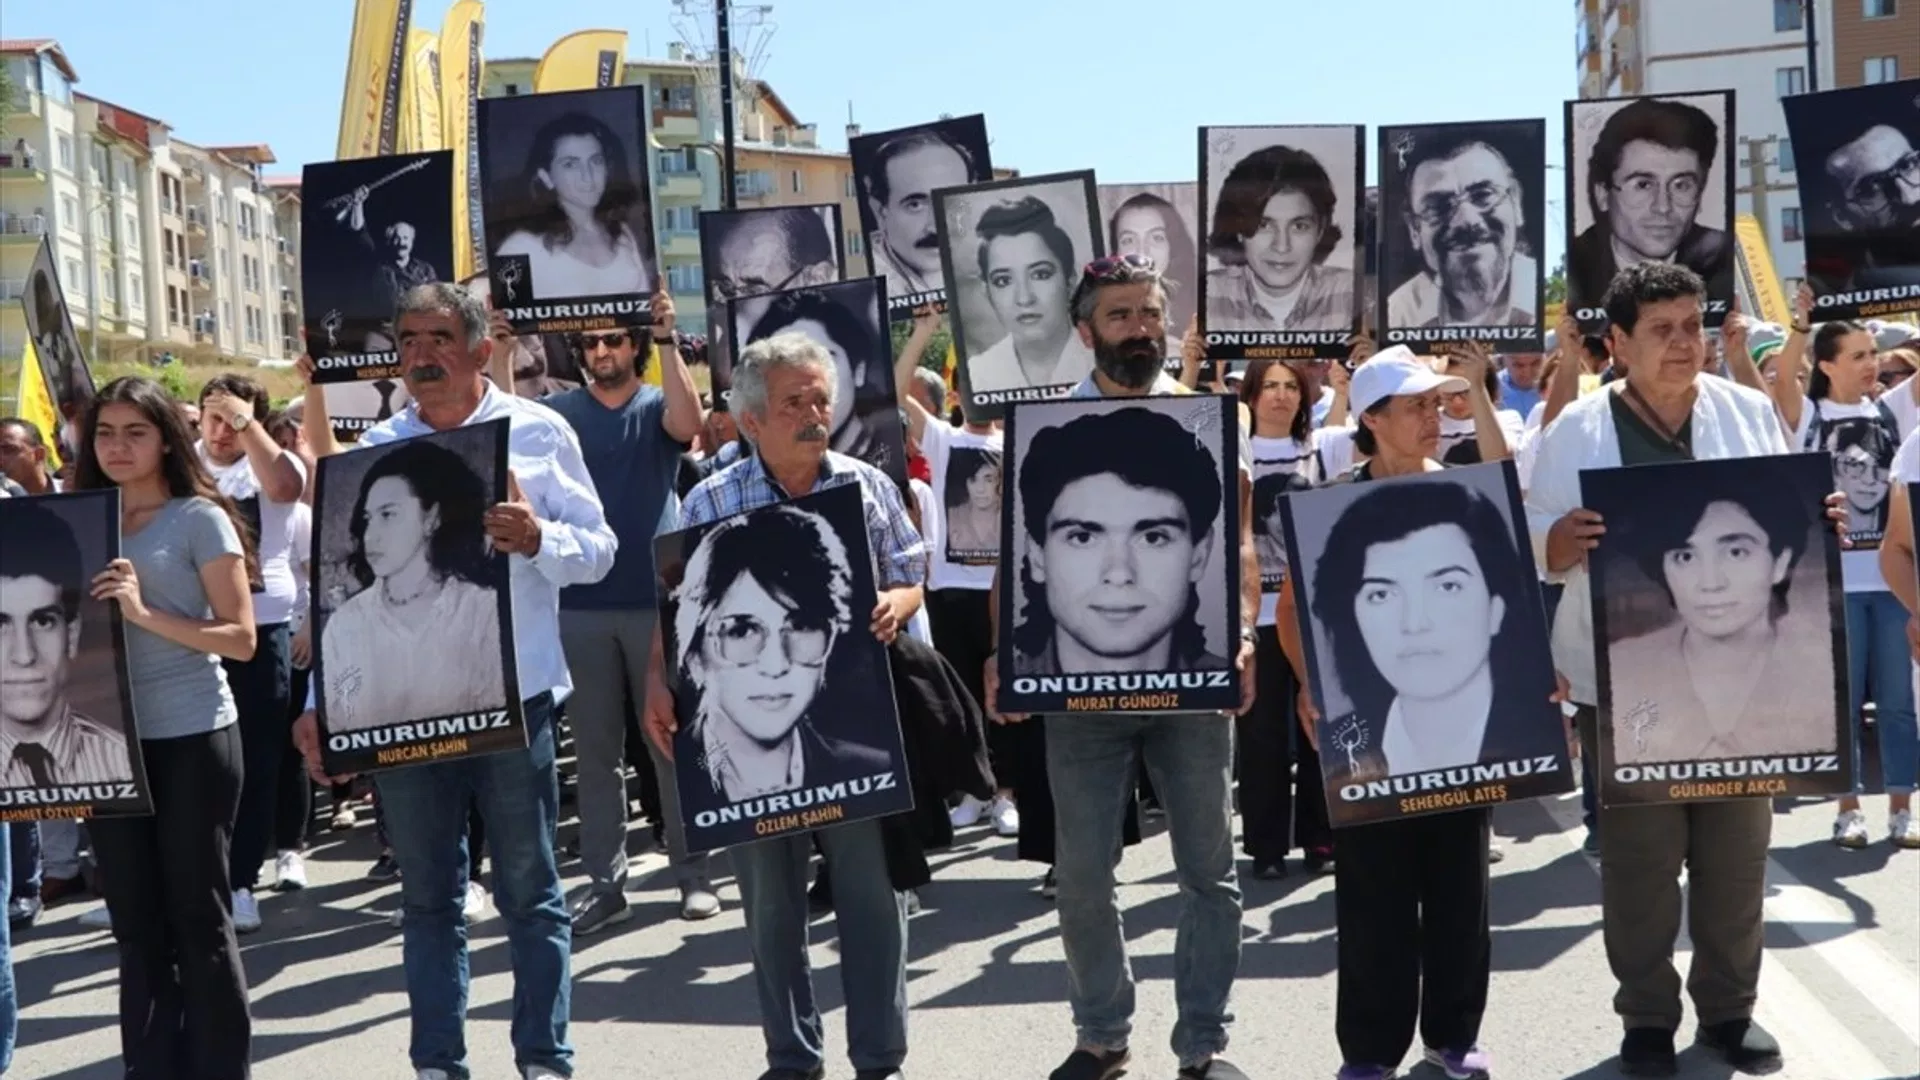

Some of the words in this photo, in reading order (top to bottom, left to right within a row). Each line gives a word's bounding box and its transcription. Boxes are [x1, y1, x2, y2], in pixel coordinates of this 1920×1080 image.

[1207, 333, 1350, 345] ONURUMUZ
[1388, 328, 1537, 341] ONURUMUZ
[318, 352, 398, 369] ONURU
[1013, 671, 1230, 694] ONURUMUZ
[1067, 696, 1115, 710] MURAT
[1119, 692, 1179, 709] GÜNDÜZ
[329, 711, 510, 751] ONURUMUZ
[378, 745, 428, 764] NURCAN
[430, 738, 468, 759] ŞAHİN
[1340, 755, 1558, 800] ONURUMUZ
[1614, 756, 1839, 783] ONURUMUZ
[694, 772, 896, 827] ONURUMUZ
[1401, 787, 1471, 813] SEHERGÜL
[1474, 785, 1507, 802] ATEŞ
[1669, 781, 1743, 798] GÜLENDER
[1747, 779, 1787, 796] AKÇA
[755, 814, 799, 835] ÖZLEM
[801, 804, 844, 828] ŞAHİN
